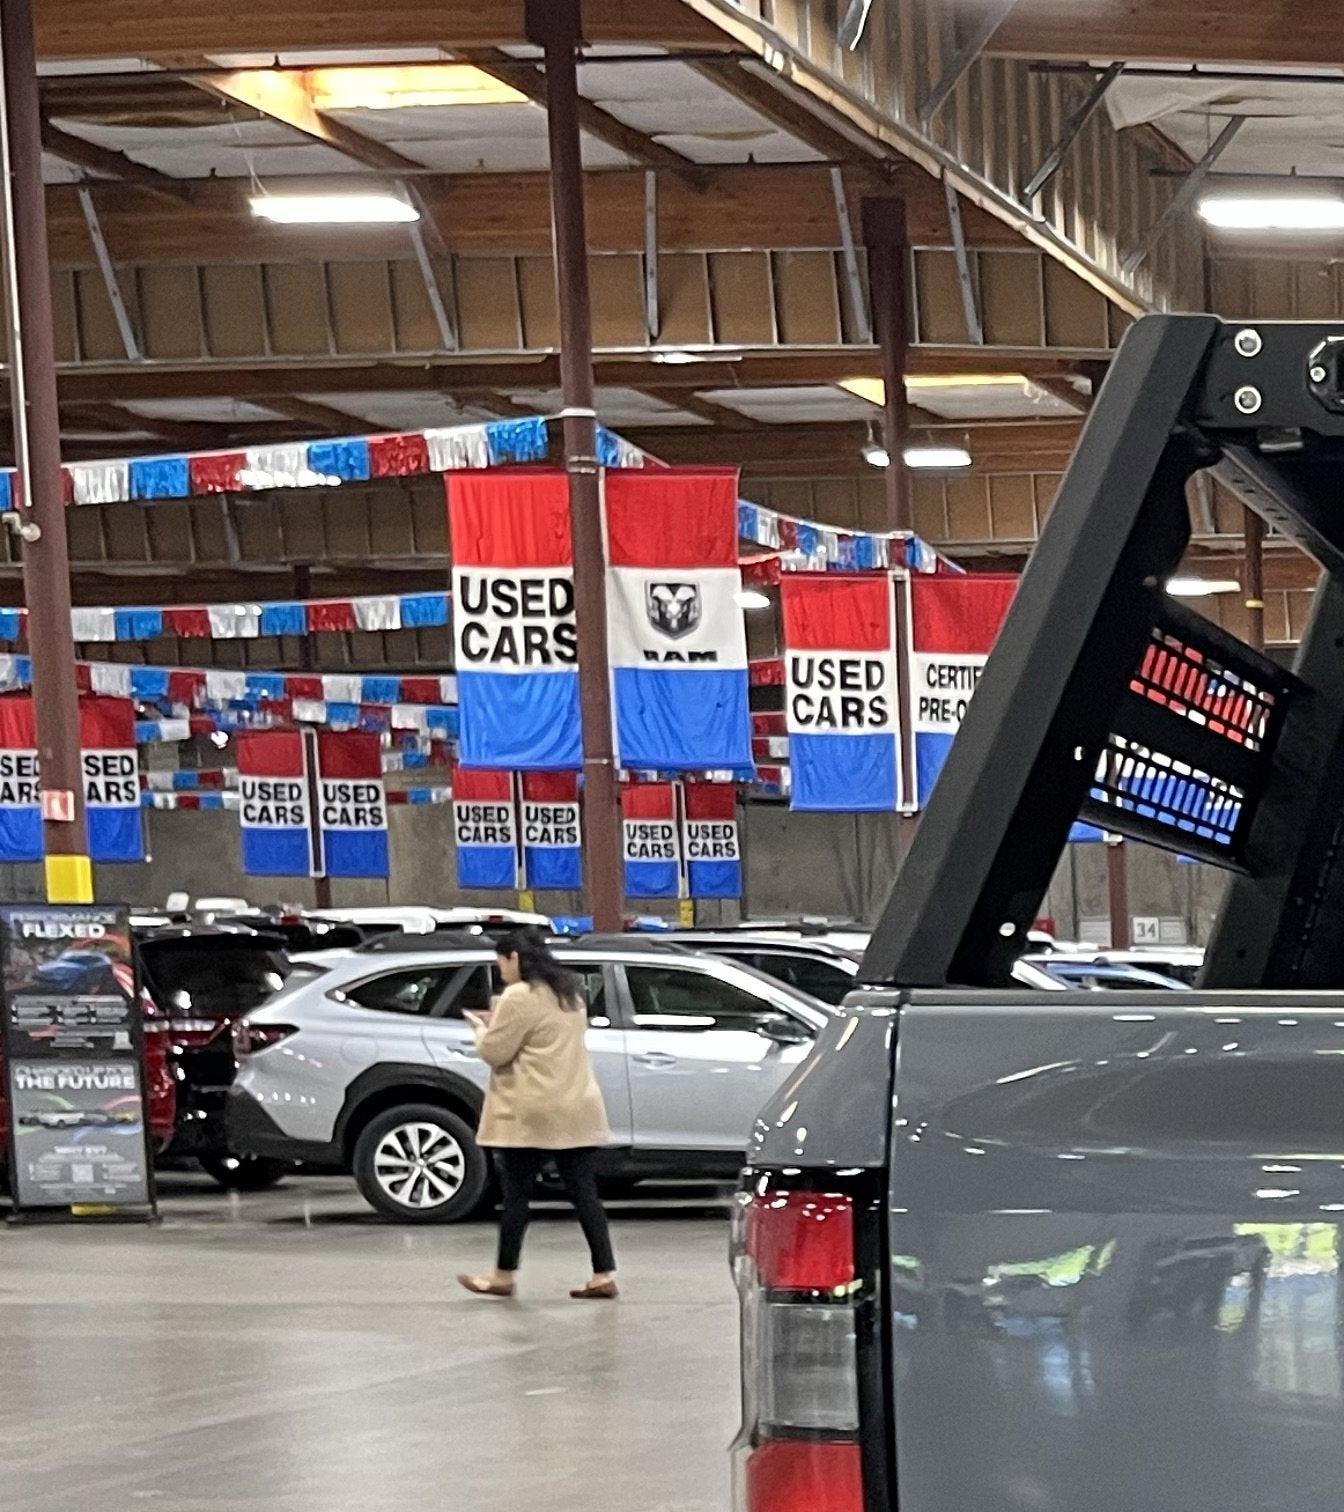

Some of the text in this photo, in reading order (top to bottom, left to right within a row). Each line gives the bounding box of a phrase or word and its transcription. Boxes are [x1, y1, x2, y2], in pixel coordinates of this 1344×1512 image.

[459, 575, 576, 619] USED
[460, 621, 578, 666] CARS
[643, 649, 718, 663] RAM
[791, 657, 886, 692] USED
[926, 663, 985, 690] CERTIF
[792, 693, 889, 729] CARS
[0, 755, 41, 778] SE
[84, 755, 135, 778] SED
[86, 781, 137, 803] ARS
[241, 780, 303, 802] USED
[322, 783, 381, 804] USED
[243, 803, 305, 825] CARS
[322, 806, 384, 827] CARS
[456, 805, 510, 824] USED
[525, 805, 576, 824] USED
[457, 825, 512, 843] CARS
[525, 825, 578, 844] CARS
[626, 823, 674, 841] USED
[687, 823, 734, 841] USED
[627, 842, 675, 858] CARS
[687, 842, 736, 858] CARS
[22, 923, 106, 938] FLEXED
[15, 1074, 136, 1090] THE FUTURE
